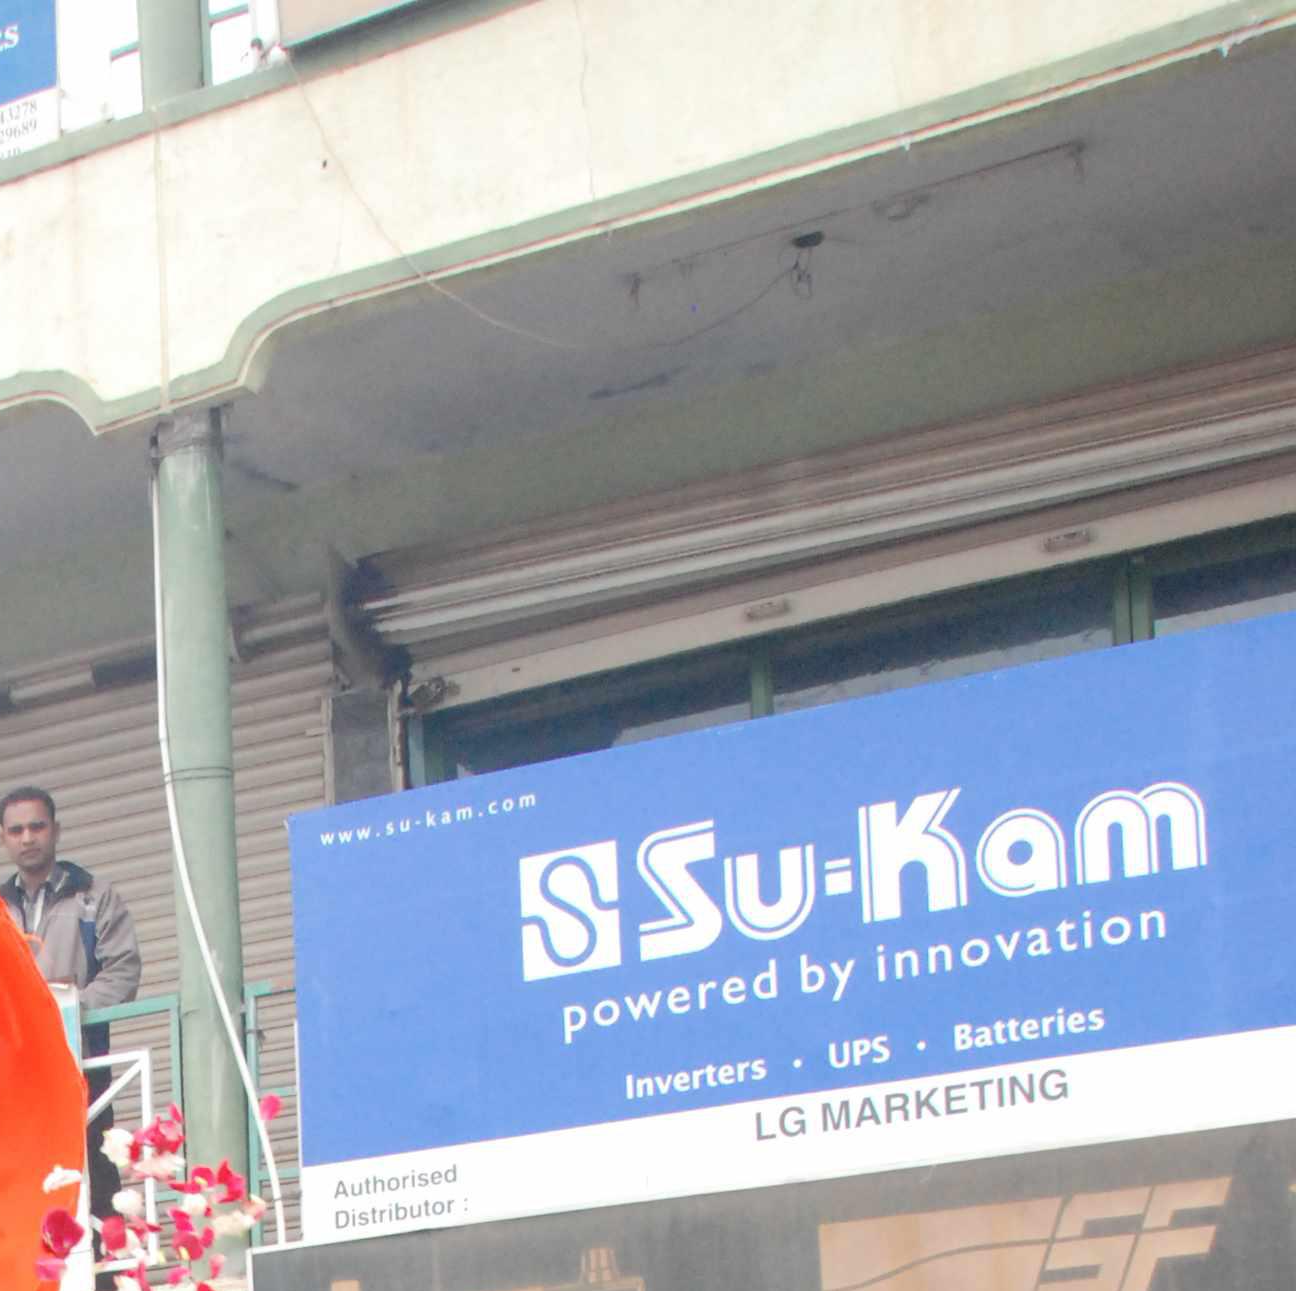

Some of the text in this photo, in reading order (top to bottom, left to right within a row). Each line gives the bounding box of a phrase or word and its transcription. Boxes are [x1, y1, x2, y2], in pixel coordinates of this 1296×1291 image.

[318, 790, 539, 847] www.su-kam.com
[562, 908, 1168, 1045] powered by innovation
[624, 1006, 1106, 1102] Inverters UPS Batteries
[754, 1067, 1071, 1144] LG MARKETING
[332, 1161, 459, 1202] Authorised
[333, 1194, 454, 1232] Distributor
